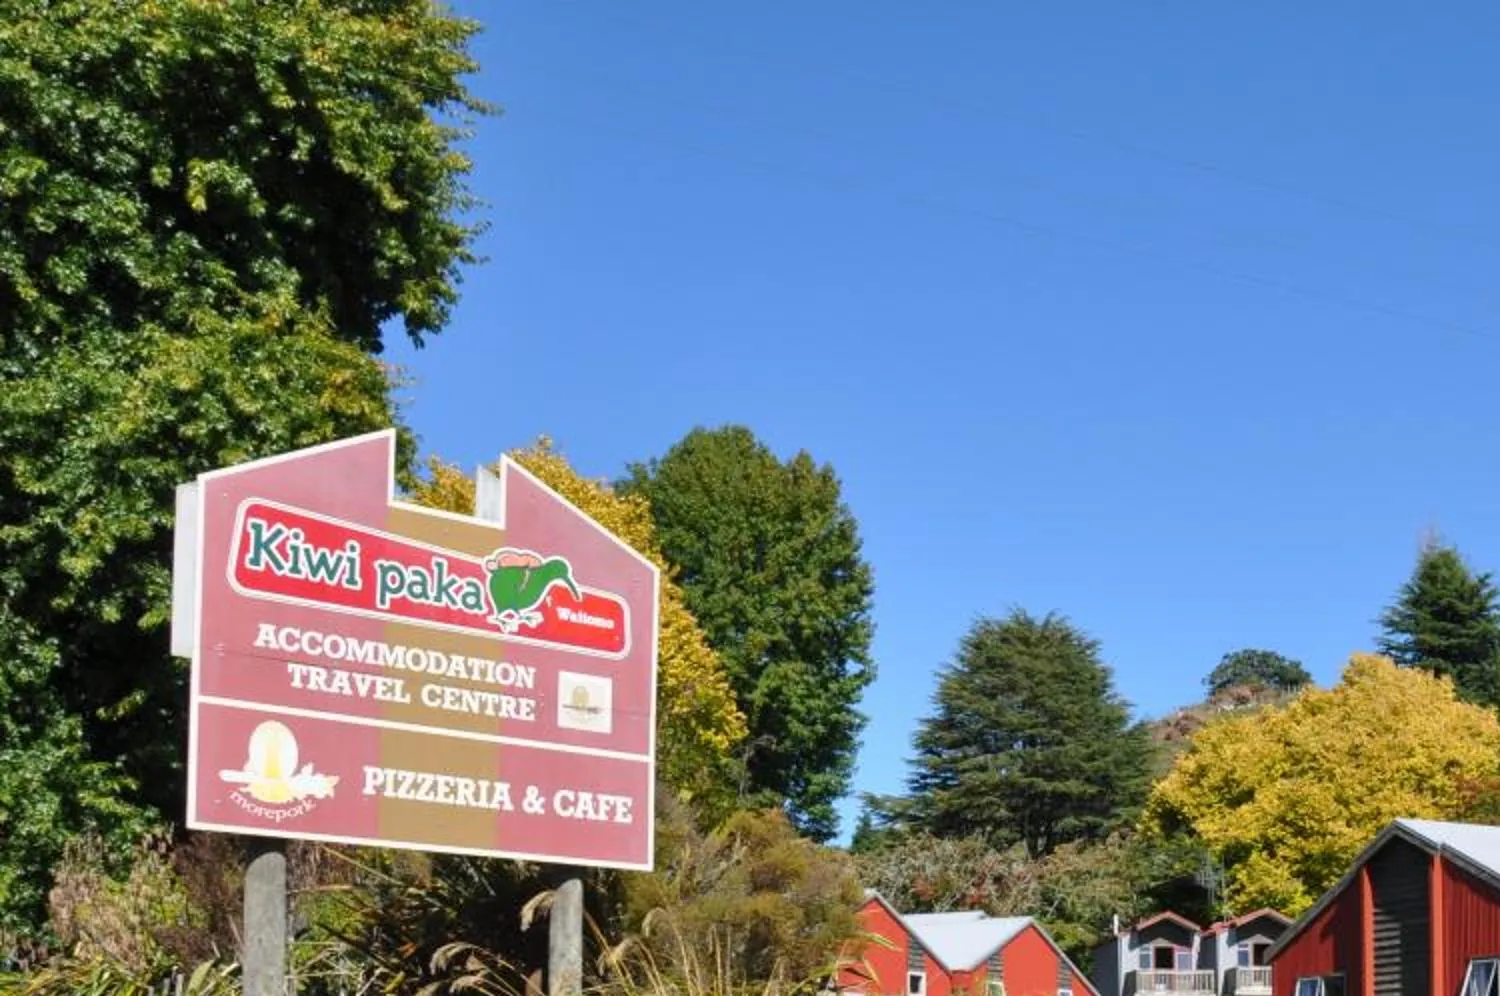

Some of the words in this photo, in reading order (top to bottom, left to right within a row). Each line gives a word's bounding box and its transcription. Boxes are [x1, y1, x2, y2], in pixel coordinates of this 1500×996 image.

[248, 520, 359, 587] Kiwi
[376, 559, 484, 612] paka
[254, 622, 537, 689] ACCOMMODATION
[287, 662, 411, 704] TRAVEL
[420, 683, 536, 721] CENTRE
[229, 790, 317, 823] morepork
[362, 765, 514, 812] PIZZERIA
[522, 785, 545, 815] &
[553, 788, 634, 824] CAFE
